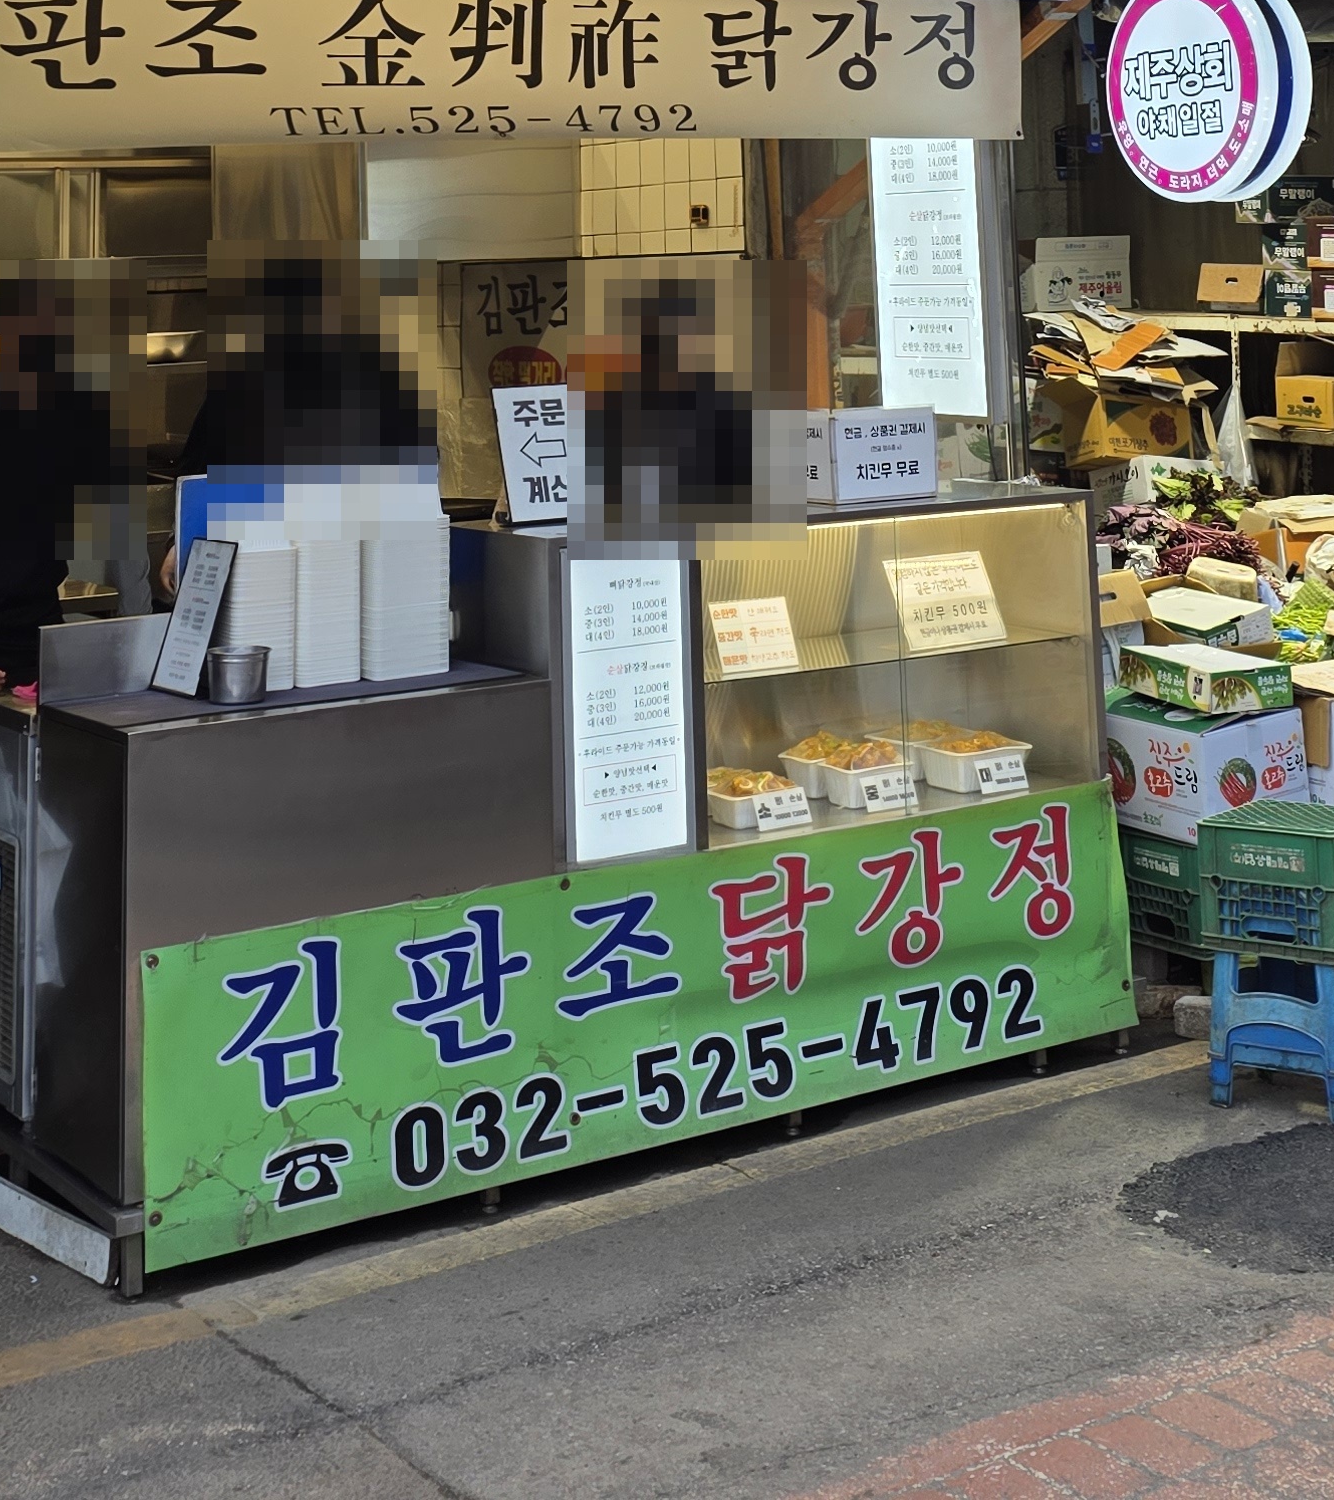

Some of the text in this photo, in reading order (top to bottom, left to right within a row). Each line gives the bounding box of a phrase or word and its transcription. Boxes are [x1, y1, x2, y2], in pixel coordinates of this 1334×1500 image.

[1124, 40, 1234, 101] 제주상회
[269, 101, 699, 138] TEL.525-4792
[1136, 100, 1223, 139] 야채일절
[1279, 188, 1315, 200] 무말랭이
[1274, 246, 1305, 258] 무말랭이
[512, 399, 565, 427] 주문
[856, 460, 920, 480] 치킨무 무료
[913, 600, 988, 623] 치킨무 500원
[219, 804, 1074, 1111] 김판조 닭강정
[390, 965, 1043, 1190] 032-525-4792
